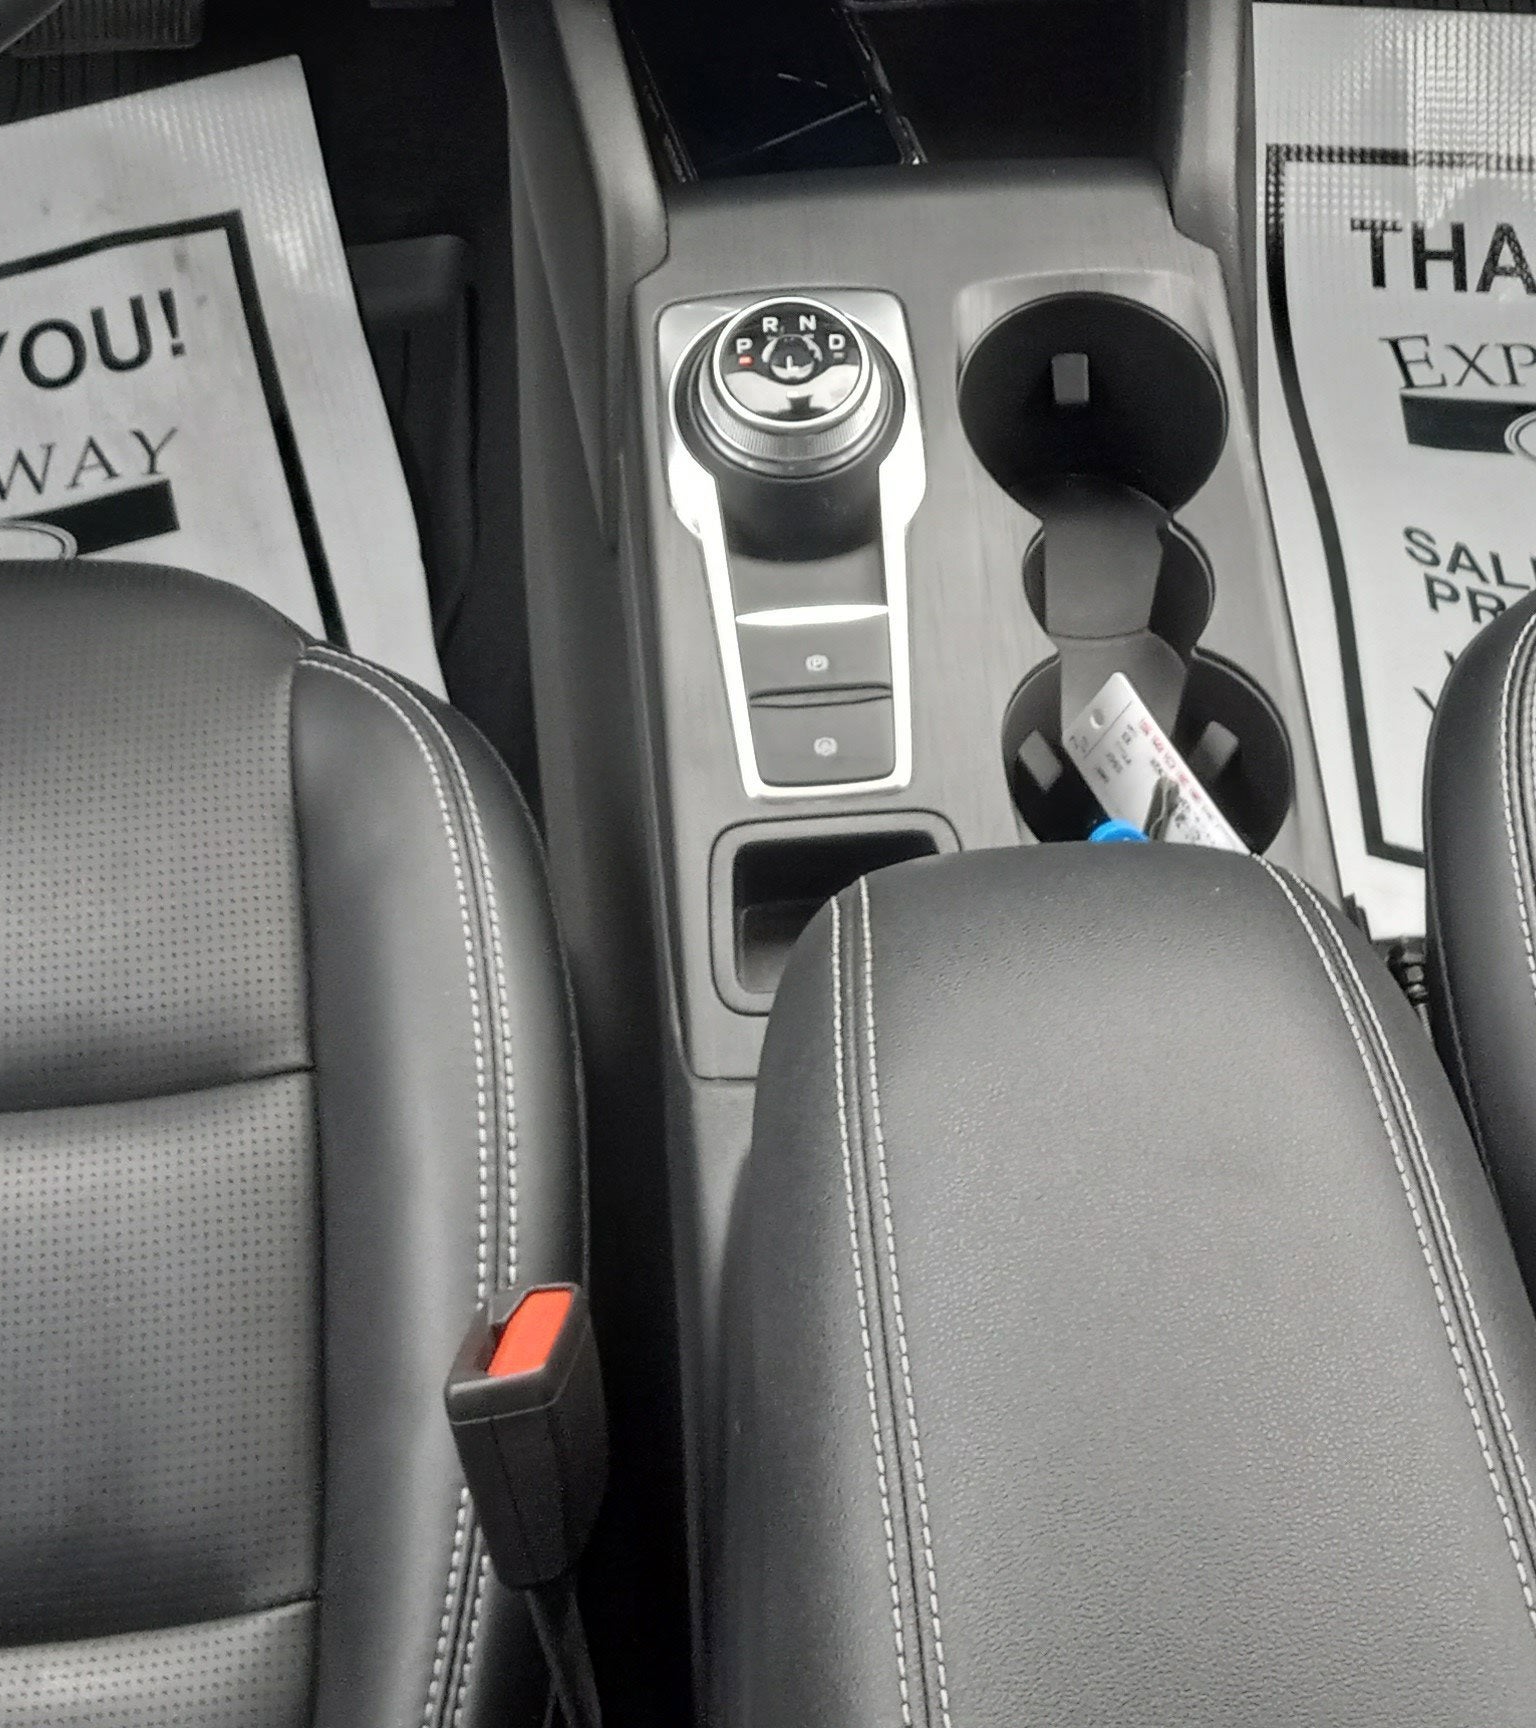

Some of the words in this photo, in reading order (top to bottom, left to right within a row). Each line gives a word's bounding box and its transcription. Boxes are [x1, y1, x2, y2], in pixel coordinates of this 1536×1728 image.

[763, 316, 779, 333] R
[798, 315, 816, 331] N
[735, 338, 753, 354] P
[828, 334, 846, 351] D
